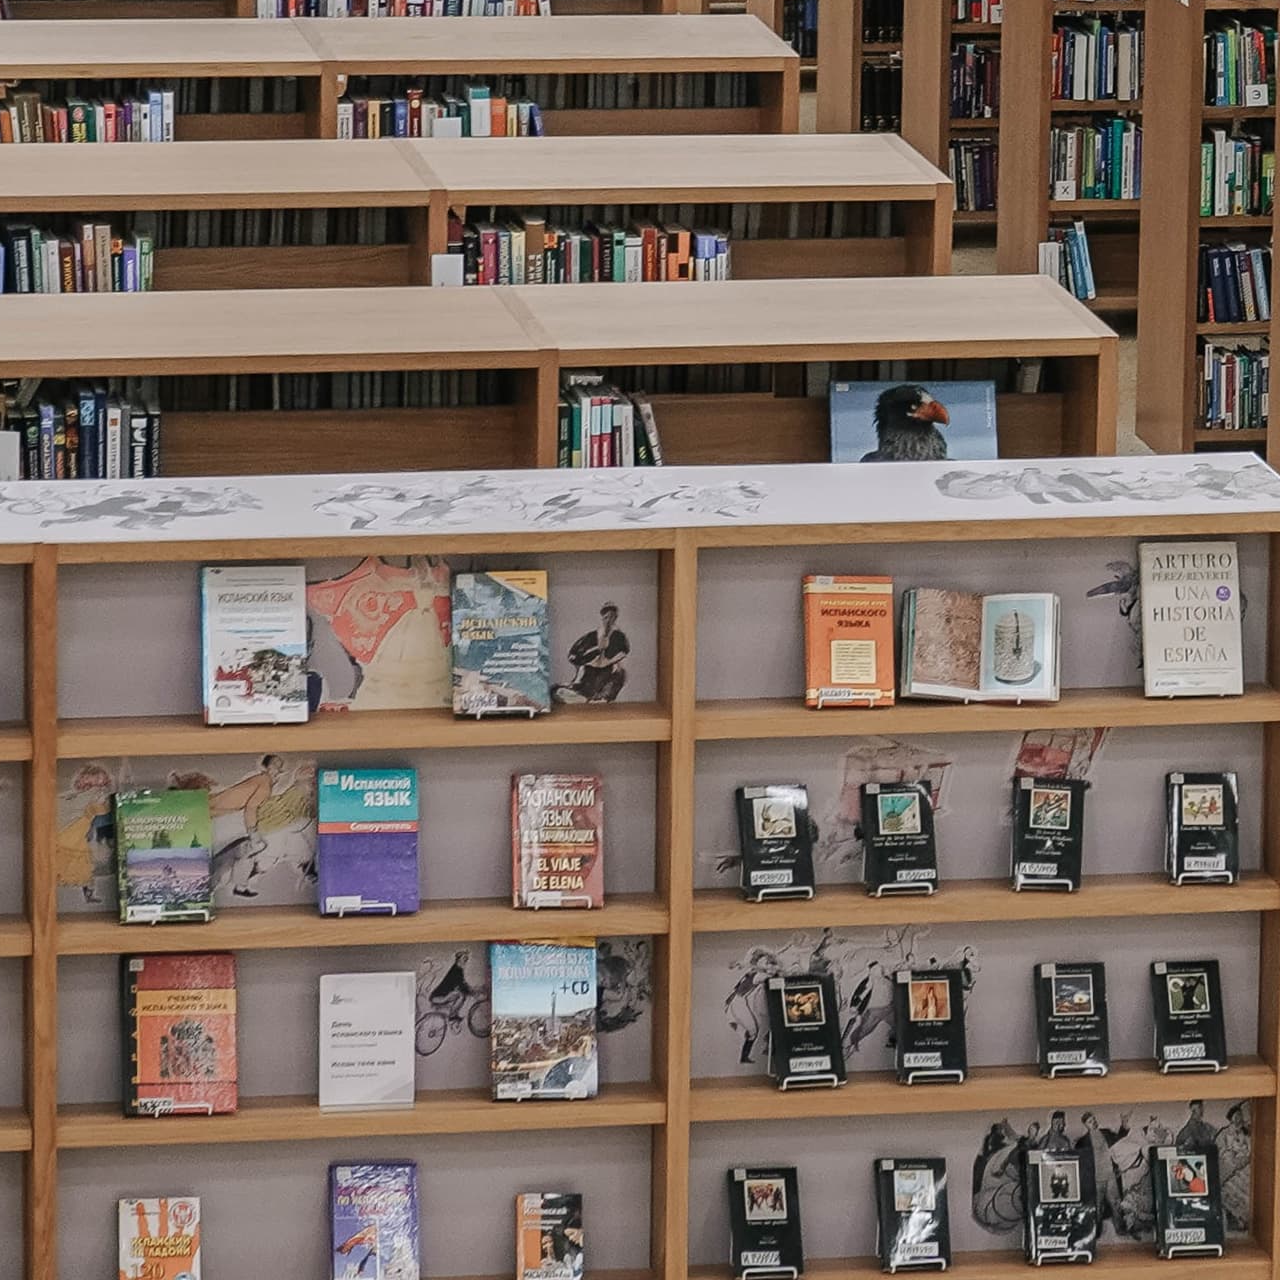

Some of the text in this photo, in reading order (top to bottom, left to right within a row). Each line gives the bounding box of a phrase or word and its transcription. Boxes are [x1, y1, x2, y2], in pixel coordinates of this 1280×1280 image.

[1151, 553, 1232, 569] ARTURO
[270, 591, 294, 603] ЯЗЫК
[1174, 585, 1210, 601] UNA
[820, 608, 887, 617] ИСПАНСКОГО
[1153, 606, 1234, 622] HISTORIA
[837, 620, 870, 628] ЯЗЫКА
[1183, 626, 1207, 642] DE
[1164, 644, 1228, 663] ESPAÑA
[363, 791, 411, 807] ЯЗЫК
[521, 785, 595, 807] ИСПАНСКИЙ
[542, 809, 573, 827] ЯЗЫК
[538, 857, 581, 872] EL VIAJE
[533, 876, 584, 889] DE ELENA
[560, 980, 590, 995] +CD
